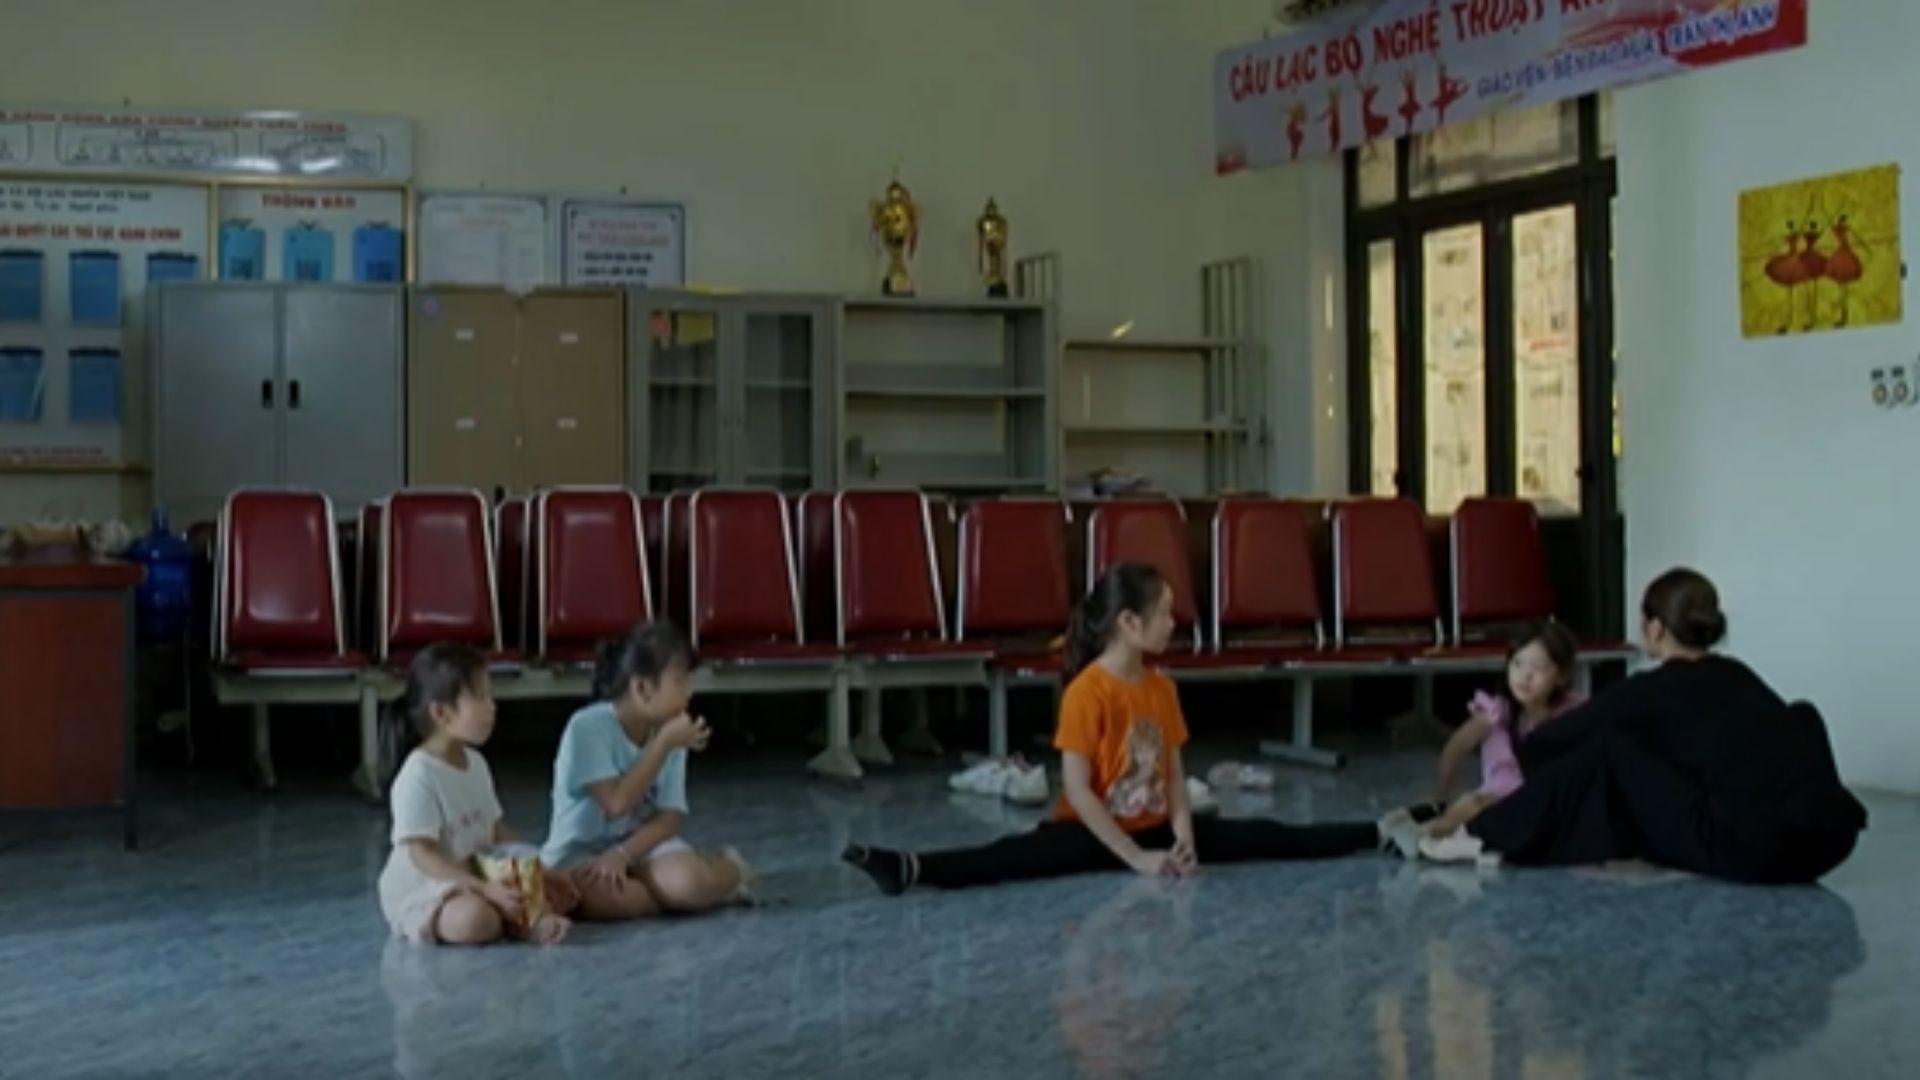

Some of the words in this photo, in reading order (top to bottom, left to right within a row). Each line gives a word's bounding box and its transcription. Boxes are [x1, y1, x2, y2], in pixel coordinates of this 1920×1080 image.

[1231, 53, 1270, 101] CÂU
[1274, 44, 1318, 93] LẠC
[1324, 24, 1363, 78] BỘ
[1371, 0, 1440, 62] NGHỆ
